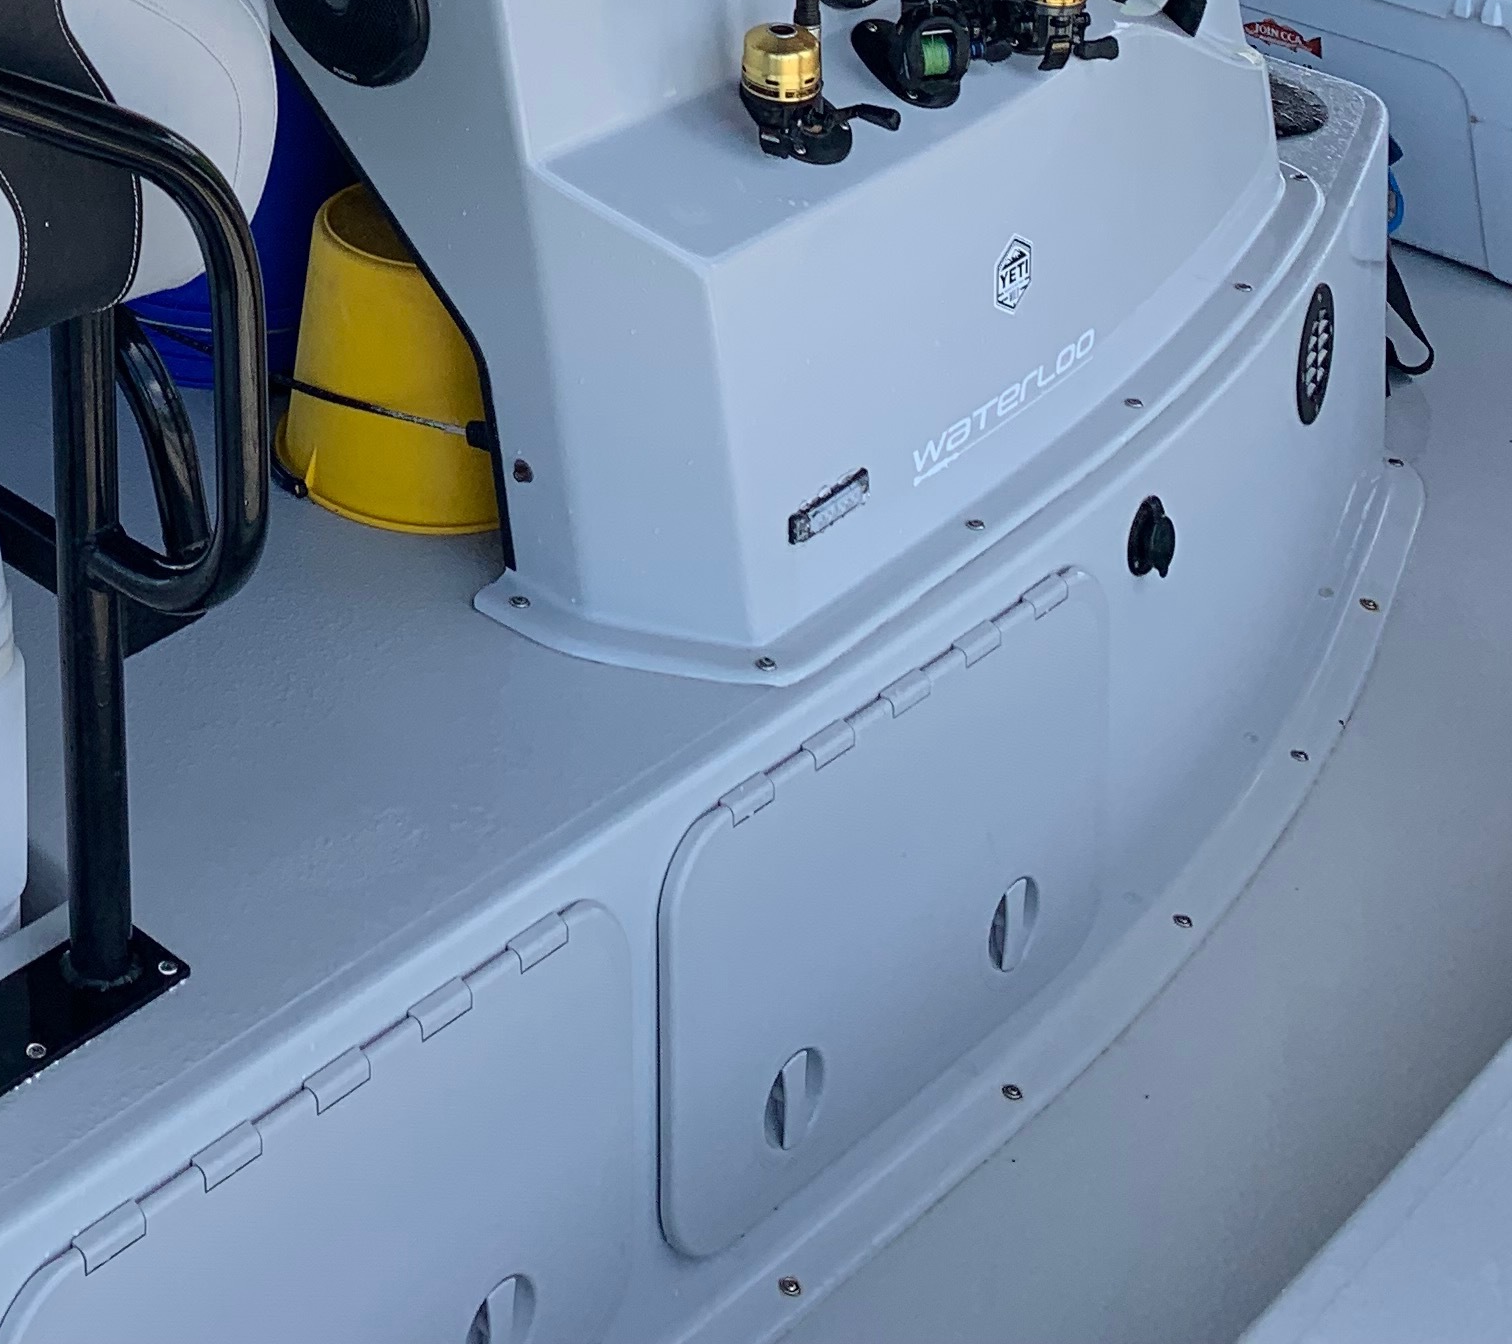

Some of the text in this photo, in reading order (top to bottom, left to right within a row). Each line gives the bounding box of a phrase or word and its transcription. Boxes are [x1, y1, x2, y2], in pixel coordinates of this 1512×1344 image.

[1255, 23, 1280, 38] JOIN
[1280, 32, 1303, 46] CCA
[1000, 258, 1029, 289] YETI
